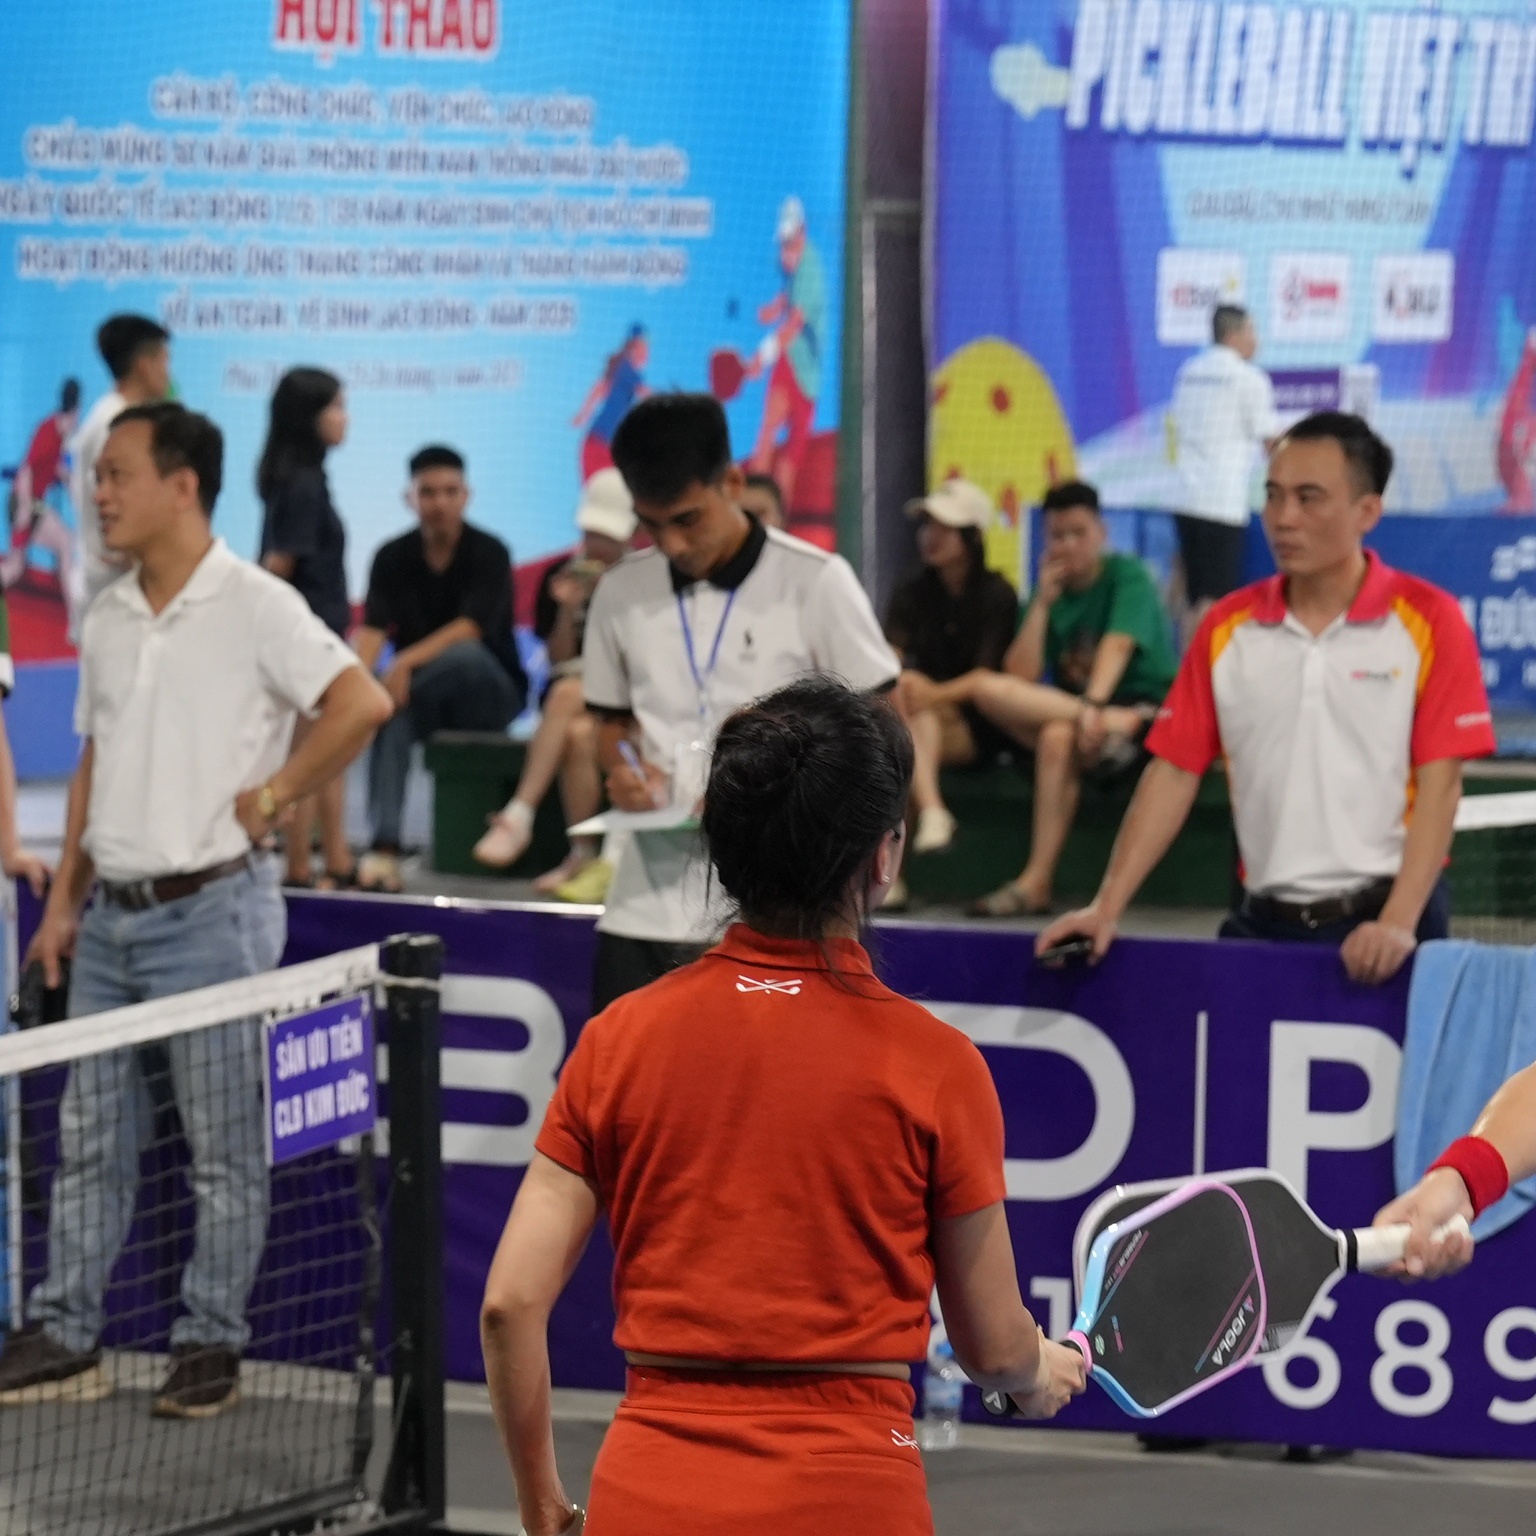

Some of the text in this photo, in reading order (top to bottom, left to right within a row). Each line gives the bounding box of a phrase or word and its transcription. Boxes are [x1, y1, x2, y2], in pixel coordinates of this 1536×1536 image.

[274, 1068, 370, 1139] CLB KIM ĐỨC
[1211, 1307, 1247, 1366] JOOLA
